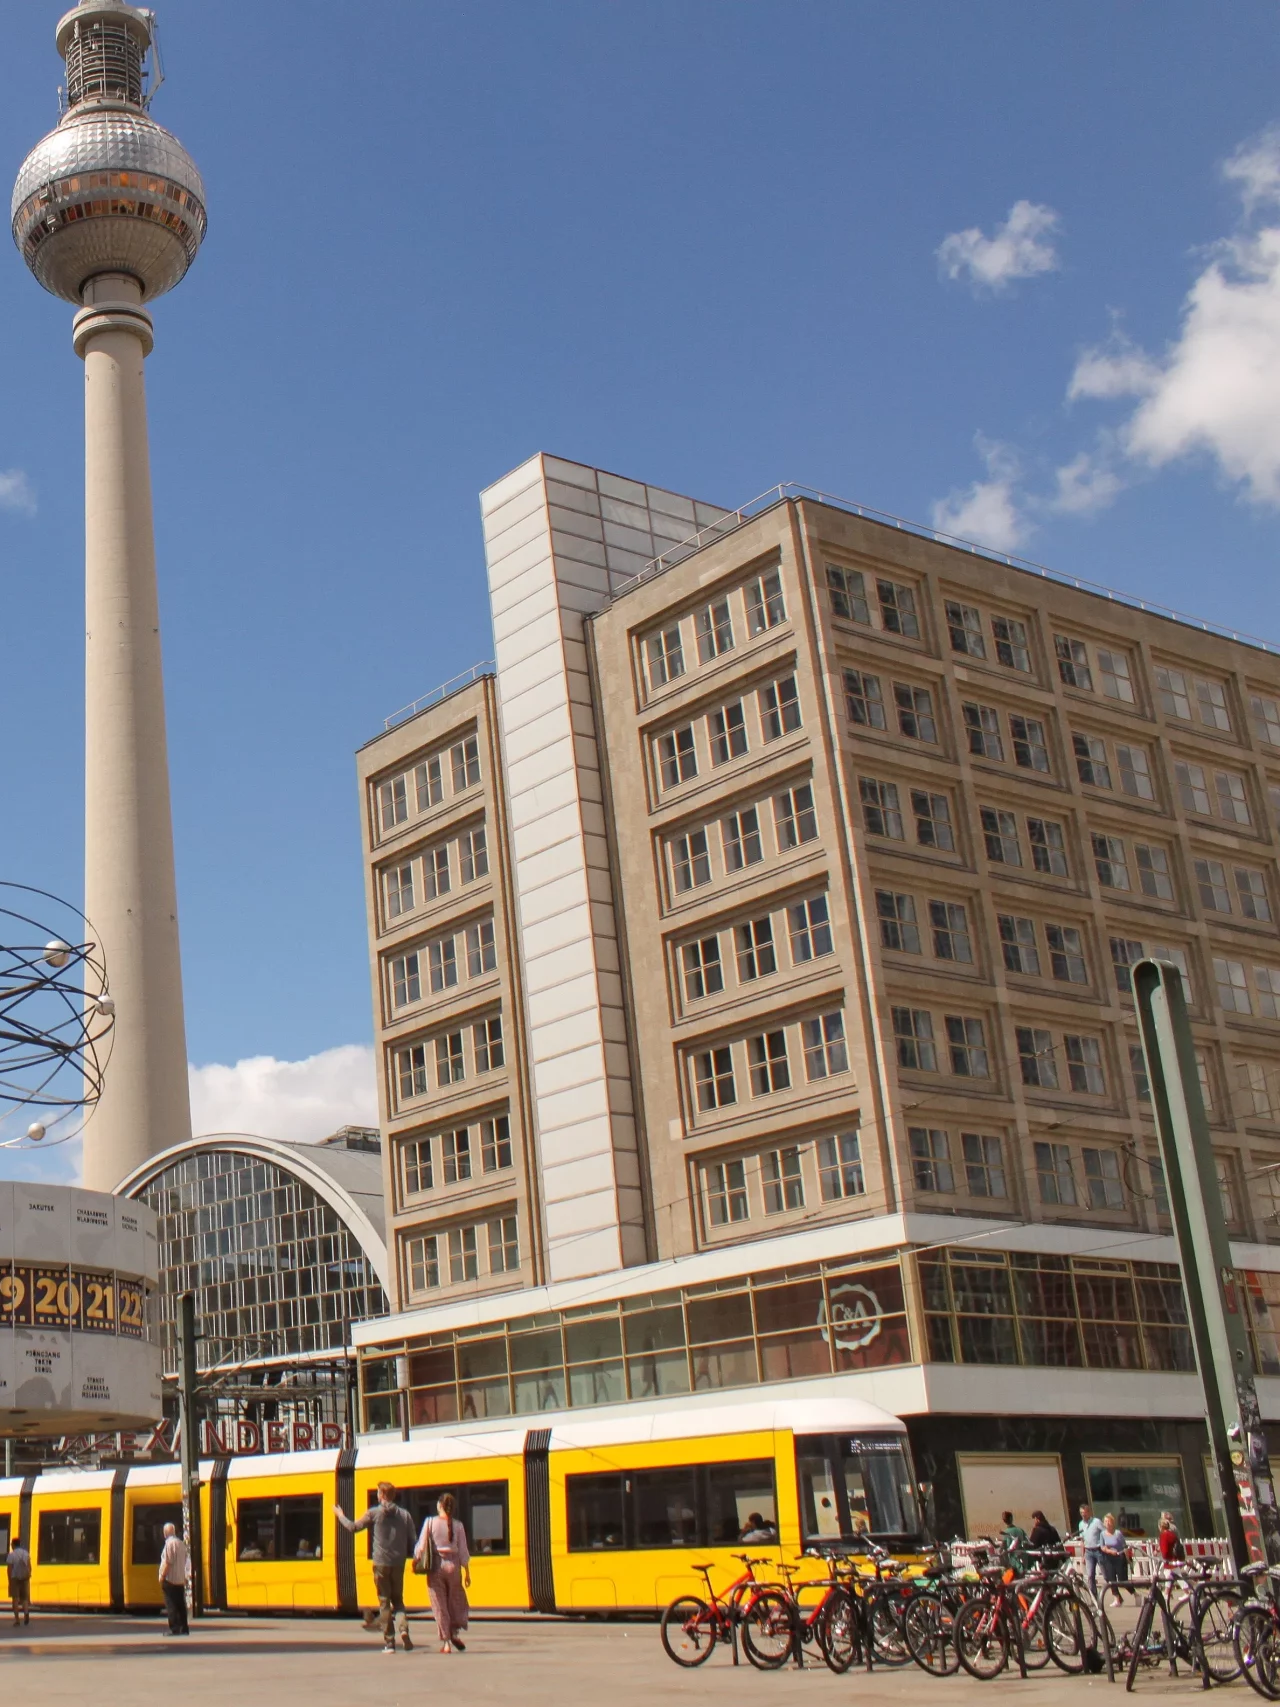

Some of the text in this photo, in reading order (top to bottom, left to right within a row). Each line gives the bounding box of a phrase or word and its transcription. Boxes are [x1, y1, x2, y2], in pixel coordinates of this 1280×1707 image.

[28, 1203, 55, 1212] JAKUTSK
[35, 1277, 81, 1317] 20
[86, 1283, 114, 1319] 21
[121, 1289, 142, 1326] 22
[832, 1300, 873, 1332] C&A
[34, 1366, 52, 1374] SEOUL
[82, 1384, 109, 1392] CANBERRA
